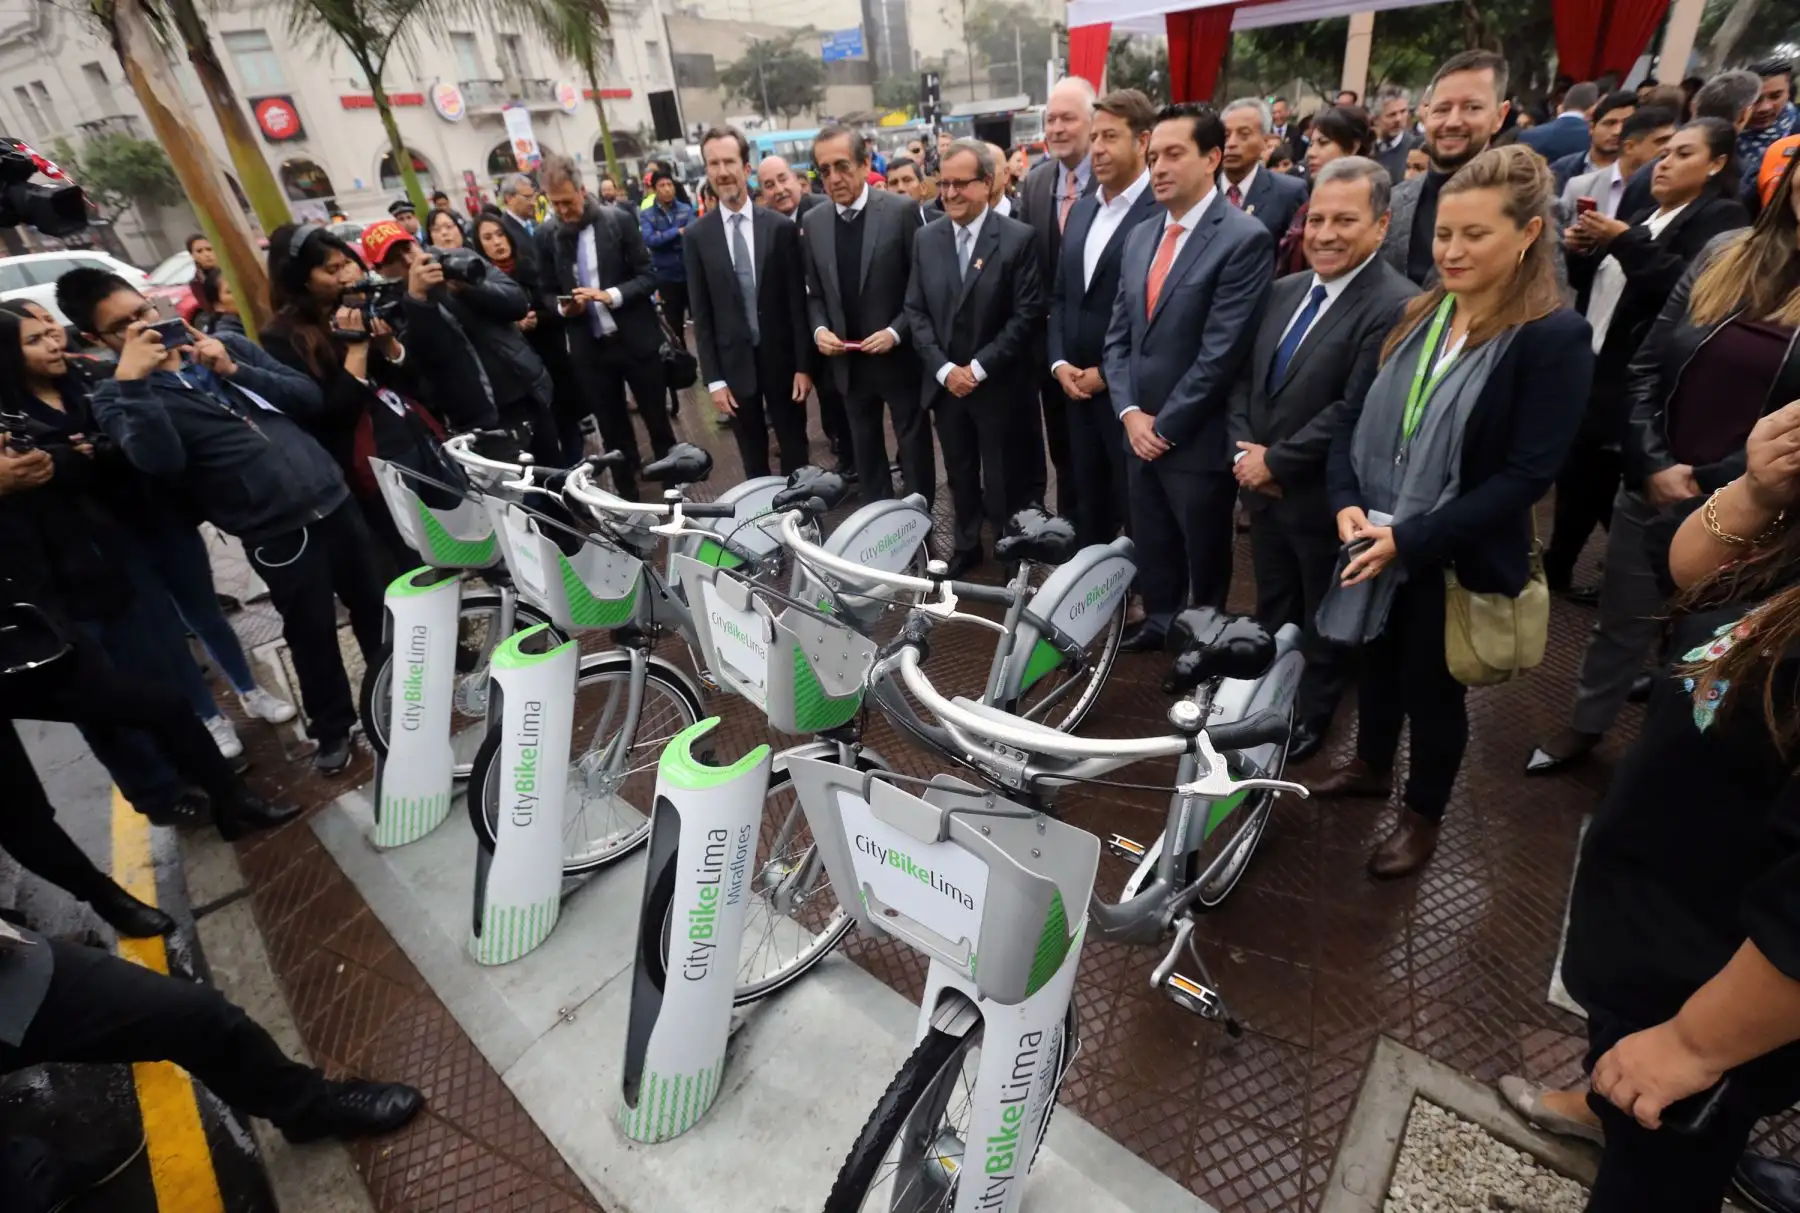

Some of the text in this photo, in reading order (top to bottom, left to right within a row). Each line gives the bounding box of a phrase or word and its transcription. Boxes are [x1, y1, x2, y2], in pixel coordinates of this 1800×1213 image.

[366, 223, 401, 247] PERU
[402, 624, 427, 731] CityBikeLima
[711, 611, 766, 660] CityBikeLima
[512, 701, 542, 827] CityBikeLima
[684, 829, 728, 981] CityBikeLima
[726, 824, 751, 906] Miraflores
[855, 834, 974, 911] CityBikeLima
[974, 1030, 1042, 1213] ityBikeLima
